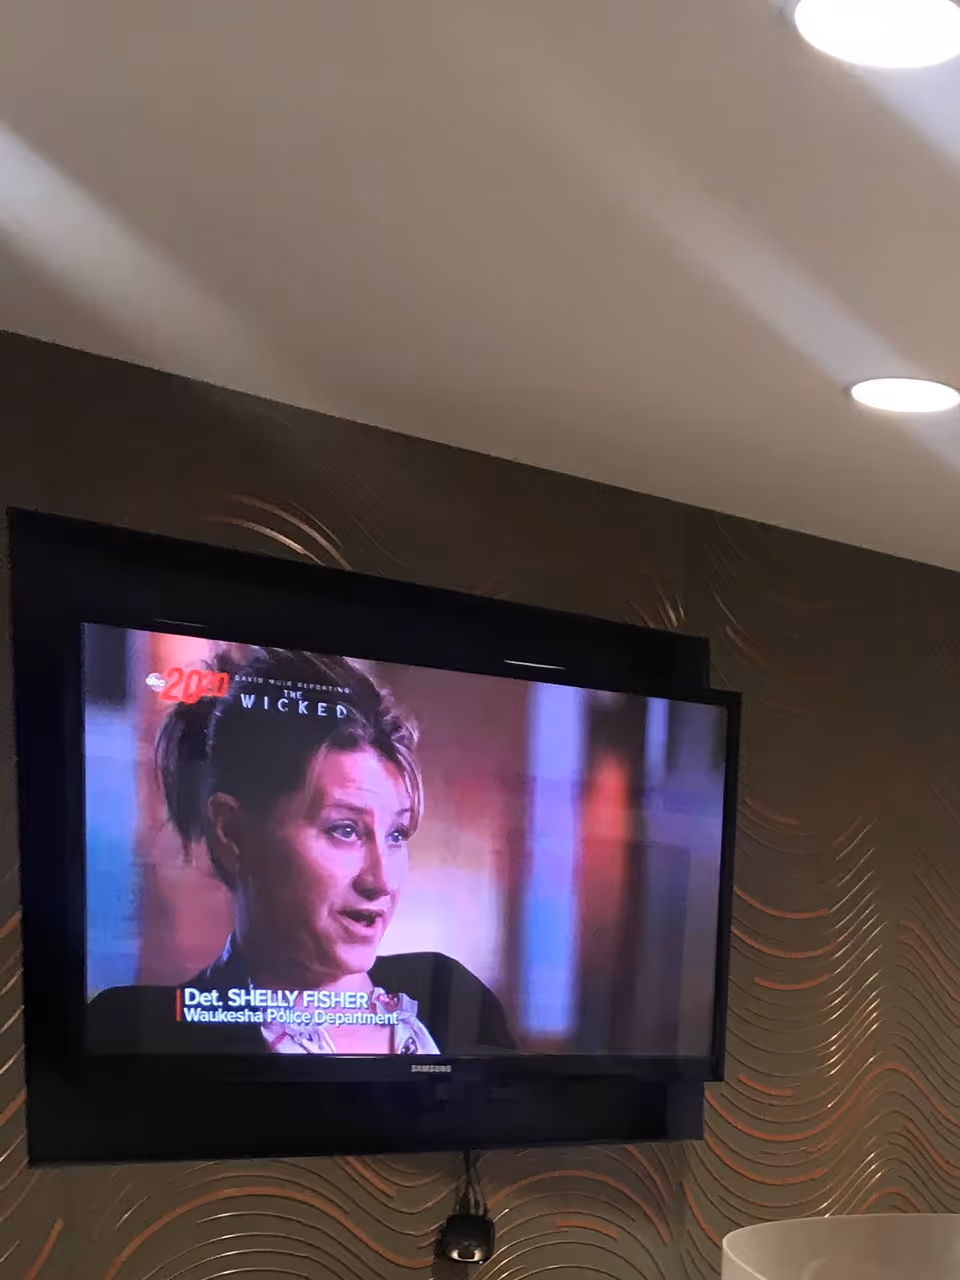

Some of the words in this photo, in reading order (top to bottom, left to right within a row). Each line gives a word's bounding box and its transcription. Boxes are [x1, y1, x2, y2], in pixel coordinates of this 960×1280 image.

[283, 689, 303, 699] THE
[240, 693, 348, 719] WICKED
[184, 988, 222, 1006] Det.
[227, 989, 299, 1007] SHELLY
[302, 990, 369, 1009] FISHER
[184, 1007, 263, 1023] Waukesha
[266, 1008, 312, 1024] Police
[314, 1010, 399, 1027] Department
[410, 1064, 452, 1073] SAMSUNG
